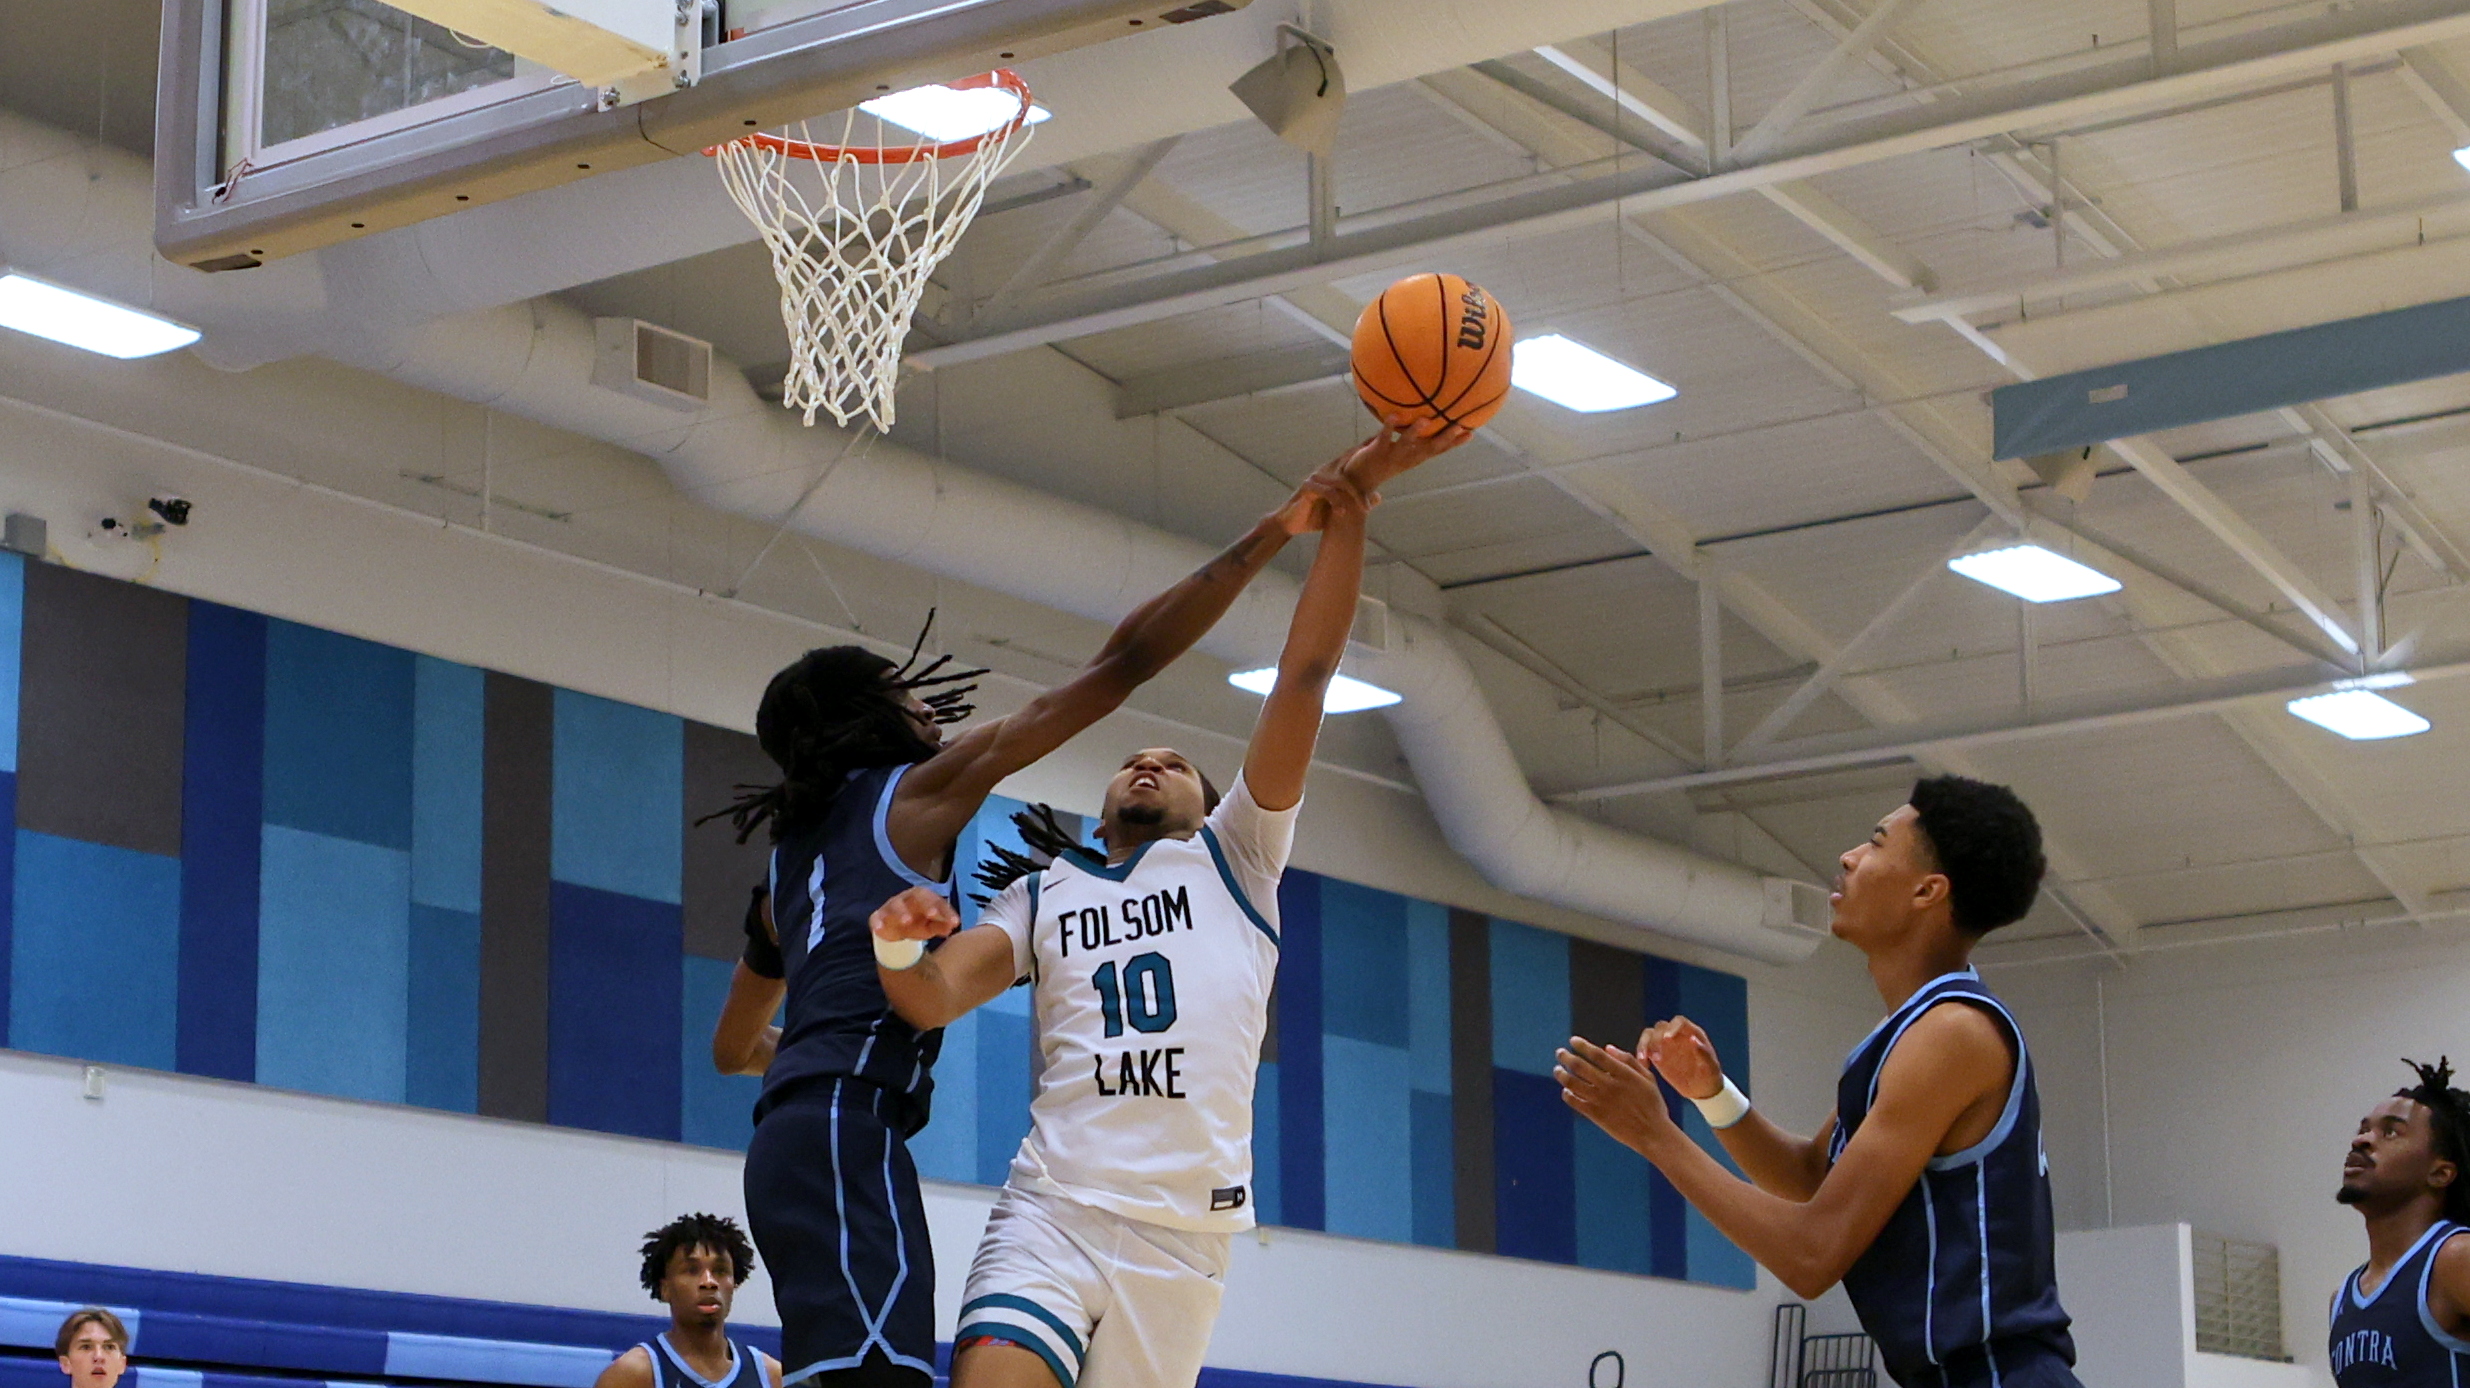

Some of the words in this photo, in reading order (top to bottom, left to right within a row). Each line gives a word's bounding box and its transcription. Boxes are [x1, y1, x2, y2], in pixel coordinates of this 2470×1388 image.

[1058, 885, 1194, 957] FOLSOM
[1092, 951, 1178, 1039] 10
[1094, 1048, 1187, 1099] LAKE
[2331, 1329, 2398, 1375] ONTRA
